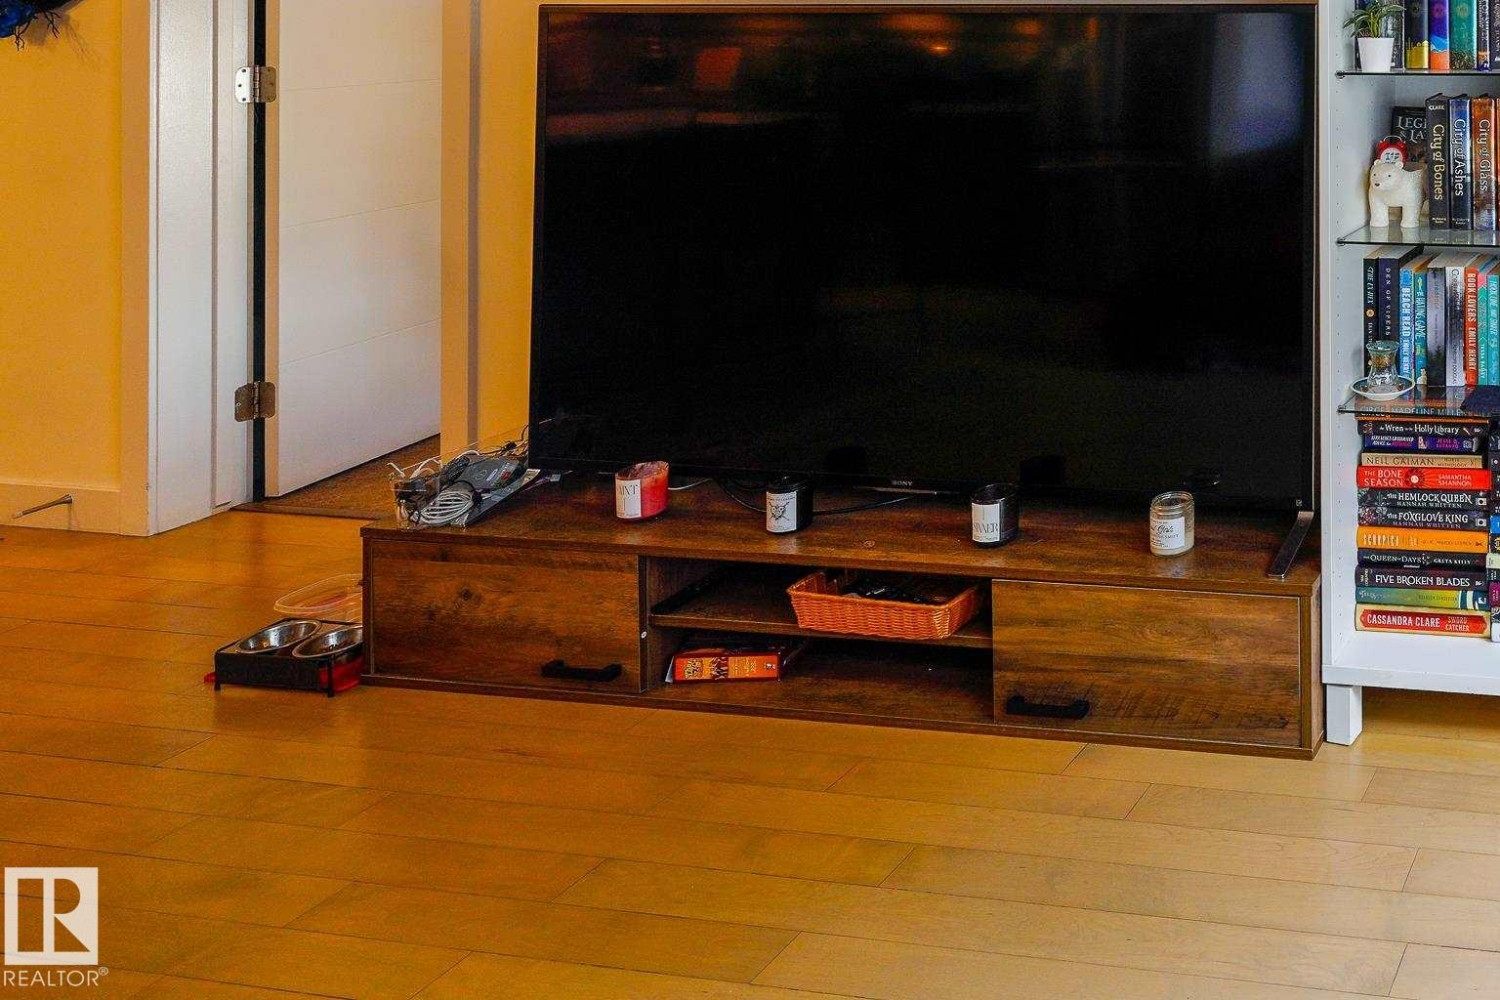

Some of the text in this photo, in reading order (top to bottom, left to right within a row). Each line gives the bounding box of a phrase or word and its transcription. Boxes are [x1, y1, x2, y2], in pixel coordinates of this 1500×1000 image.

[1452, 119, 1466, 196] City of Ashes
[1477, 119, 1491, 191] City Glass
[1430, 124, 1445, 200] City of Bones
[1402, 287, 1411, 337] BEACH READ
[1468, 273, 1477, 370] BOOK LOVERS EMILY HENRY
[1415, 320, 1425, 340] GAME
[1385, 424, 1459, 435] Wren Holly Library
[1366, 457, 1435, 466] NEIL GAIMAN
[1364, 479, 1404, 487] SEASON
[1398, 493, 1473, 504] HEMLOCK QUEEN
[1398, 512, 1469, 523] FOXGLOVE KING
[1375, 575, 1471, 586] FIVE BROKEN BLADES
[1367, 614, 1441, 628] CASSANDRA CLARE
[1447, 616, 1468, 624] SWORD
